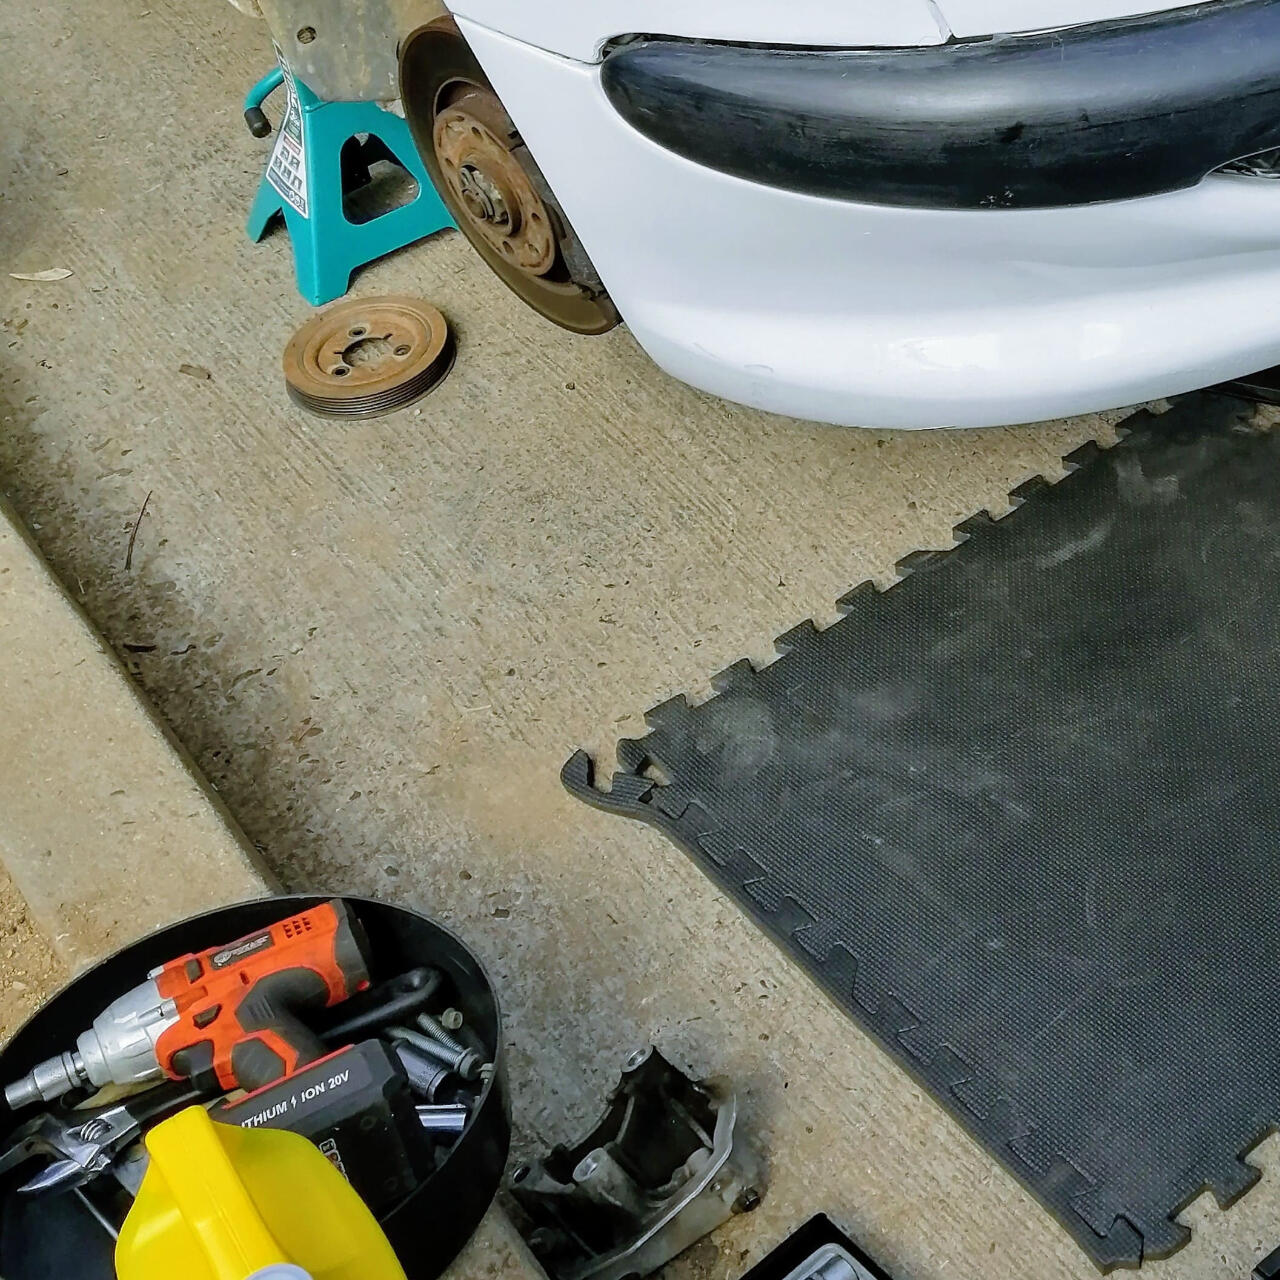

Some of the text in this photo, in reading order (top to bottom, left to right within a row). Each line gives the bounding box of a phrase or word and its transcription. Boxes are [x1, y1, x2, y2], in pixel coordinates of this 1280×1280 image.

[241, 1070, 349, 1128] ITHIUM ION 20V
